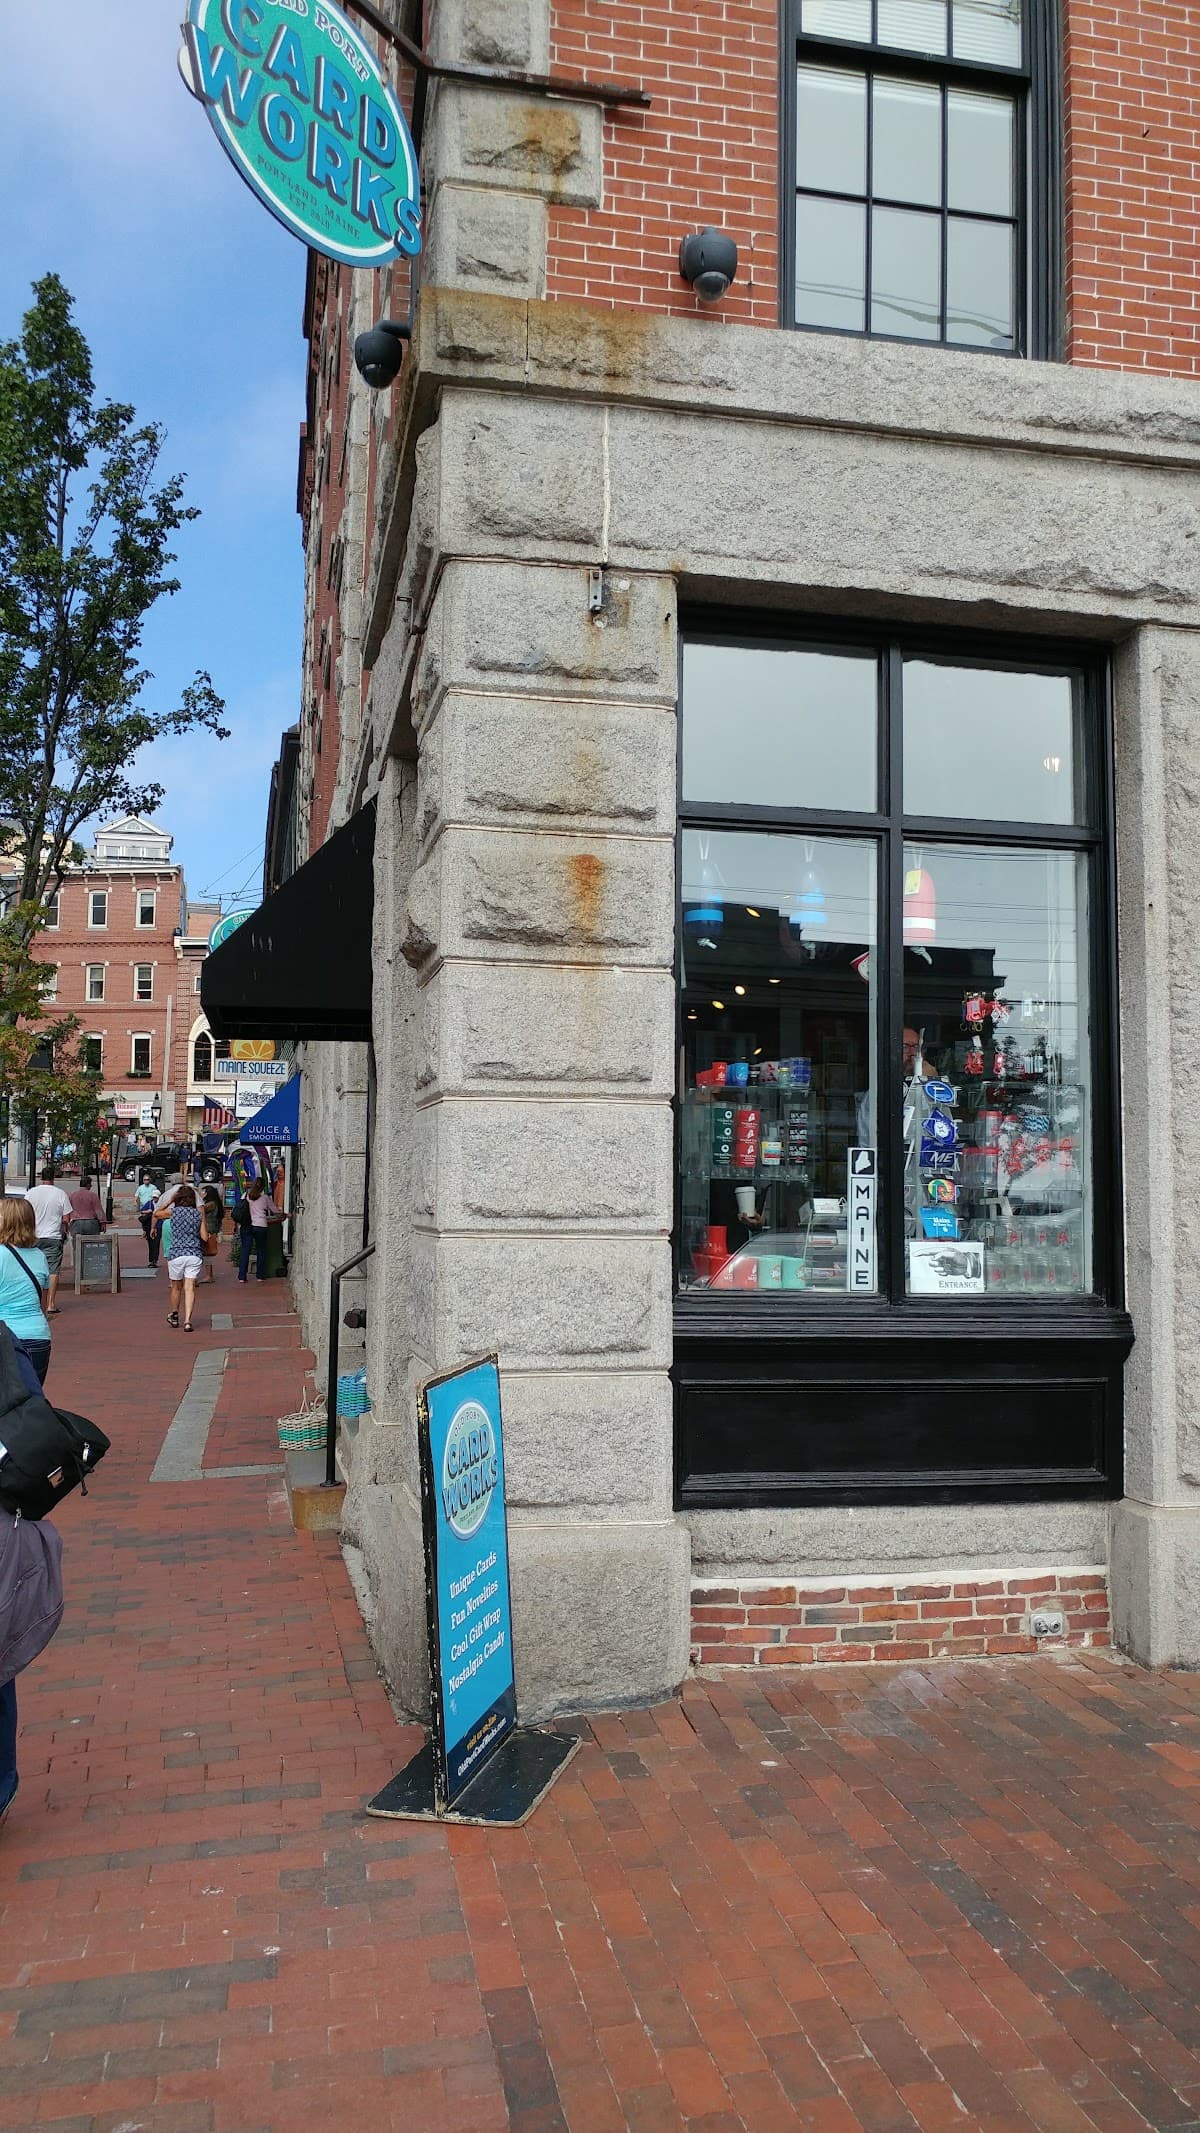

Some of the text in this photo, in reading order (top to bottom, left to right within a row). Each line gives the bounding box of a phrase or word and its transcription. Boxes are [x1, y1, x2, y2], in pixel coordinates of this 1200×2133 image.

[315, 6, 370, 82] PORT
[220, 0, 397, 169] CARD
[183, 22, 423, 259] WORKS
[257, 154, 361, 240] PORTLAND MAINE
[217, 1061, 286, 1075] MAINE SQUEEZE
[248, 1126, 290, 1134] JUICE &
[855, 1184, 870, 1285] MAINE
[938, 1281, 979, 1289] ENTRANCE
[447, 1423, 490, 1480] CARD
[442, 1455, 498, 1522] WORKS
[450, 1551, 497, 1599] Unique Cards
[451, 1580, 499, 1630] Fun Novelties
[448, 1631, 505, 1696] Nostalgia Candy
[451, 1608, 501, 1661] Cool Gift Wrap
